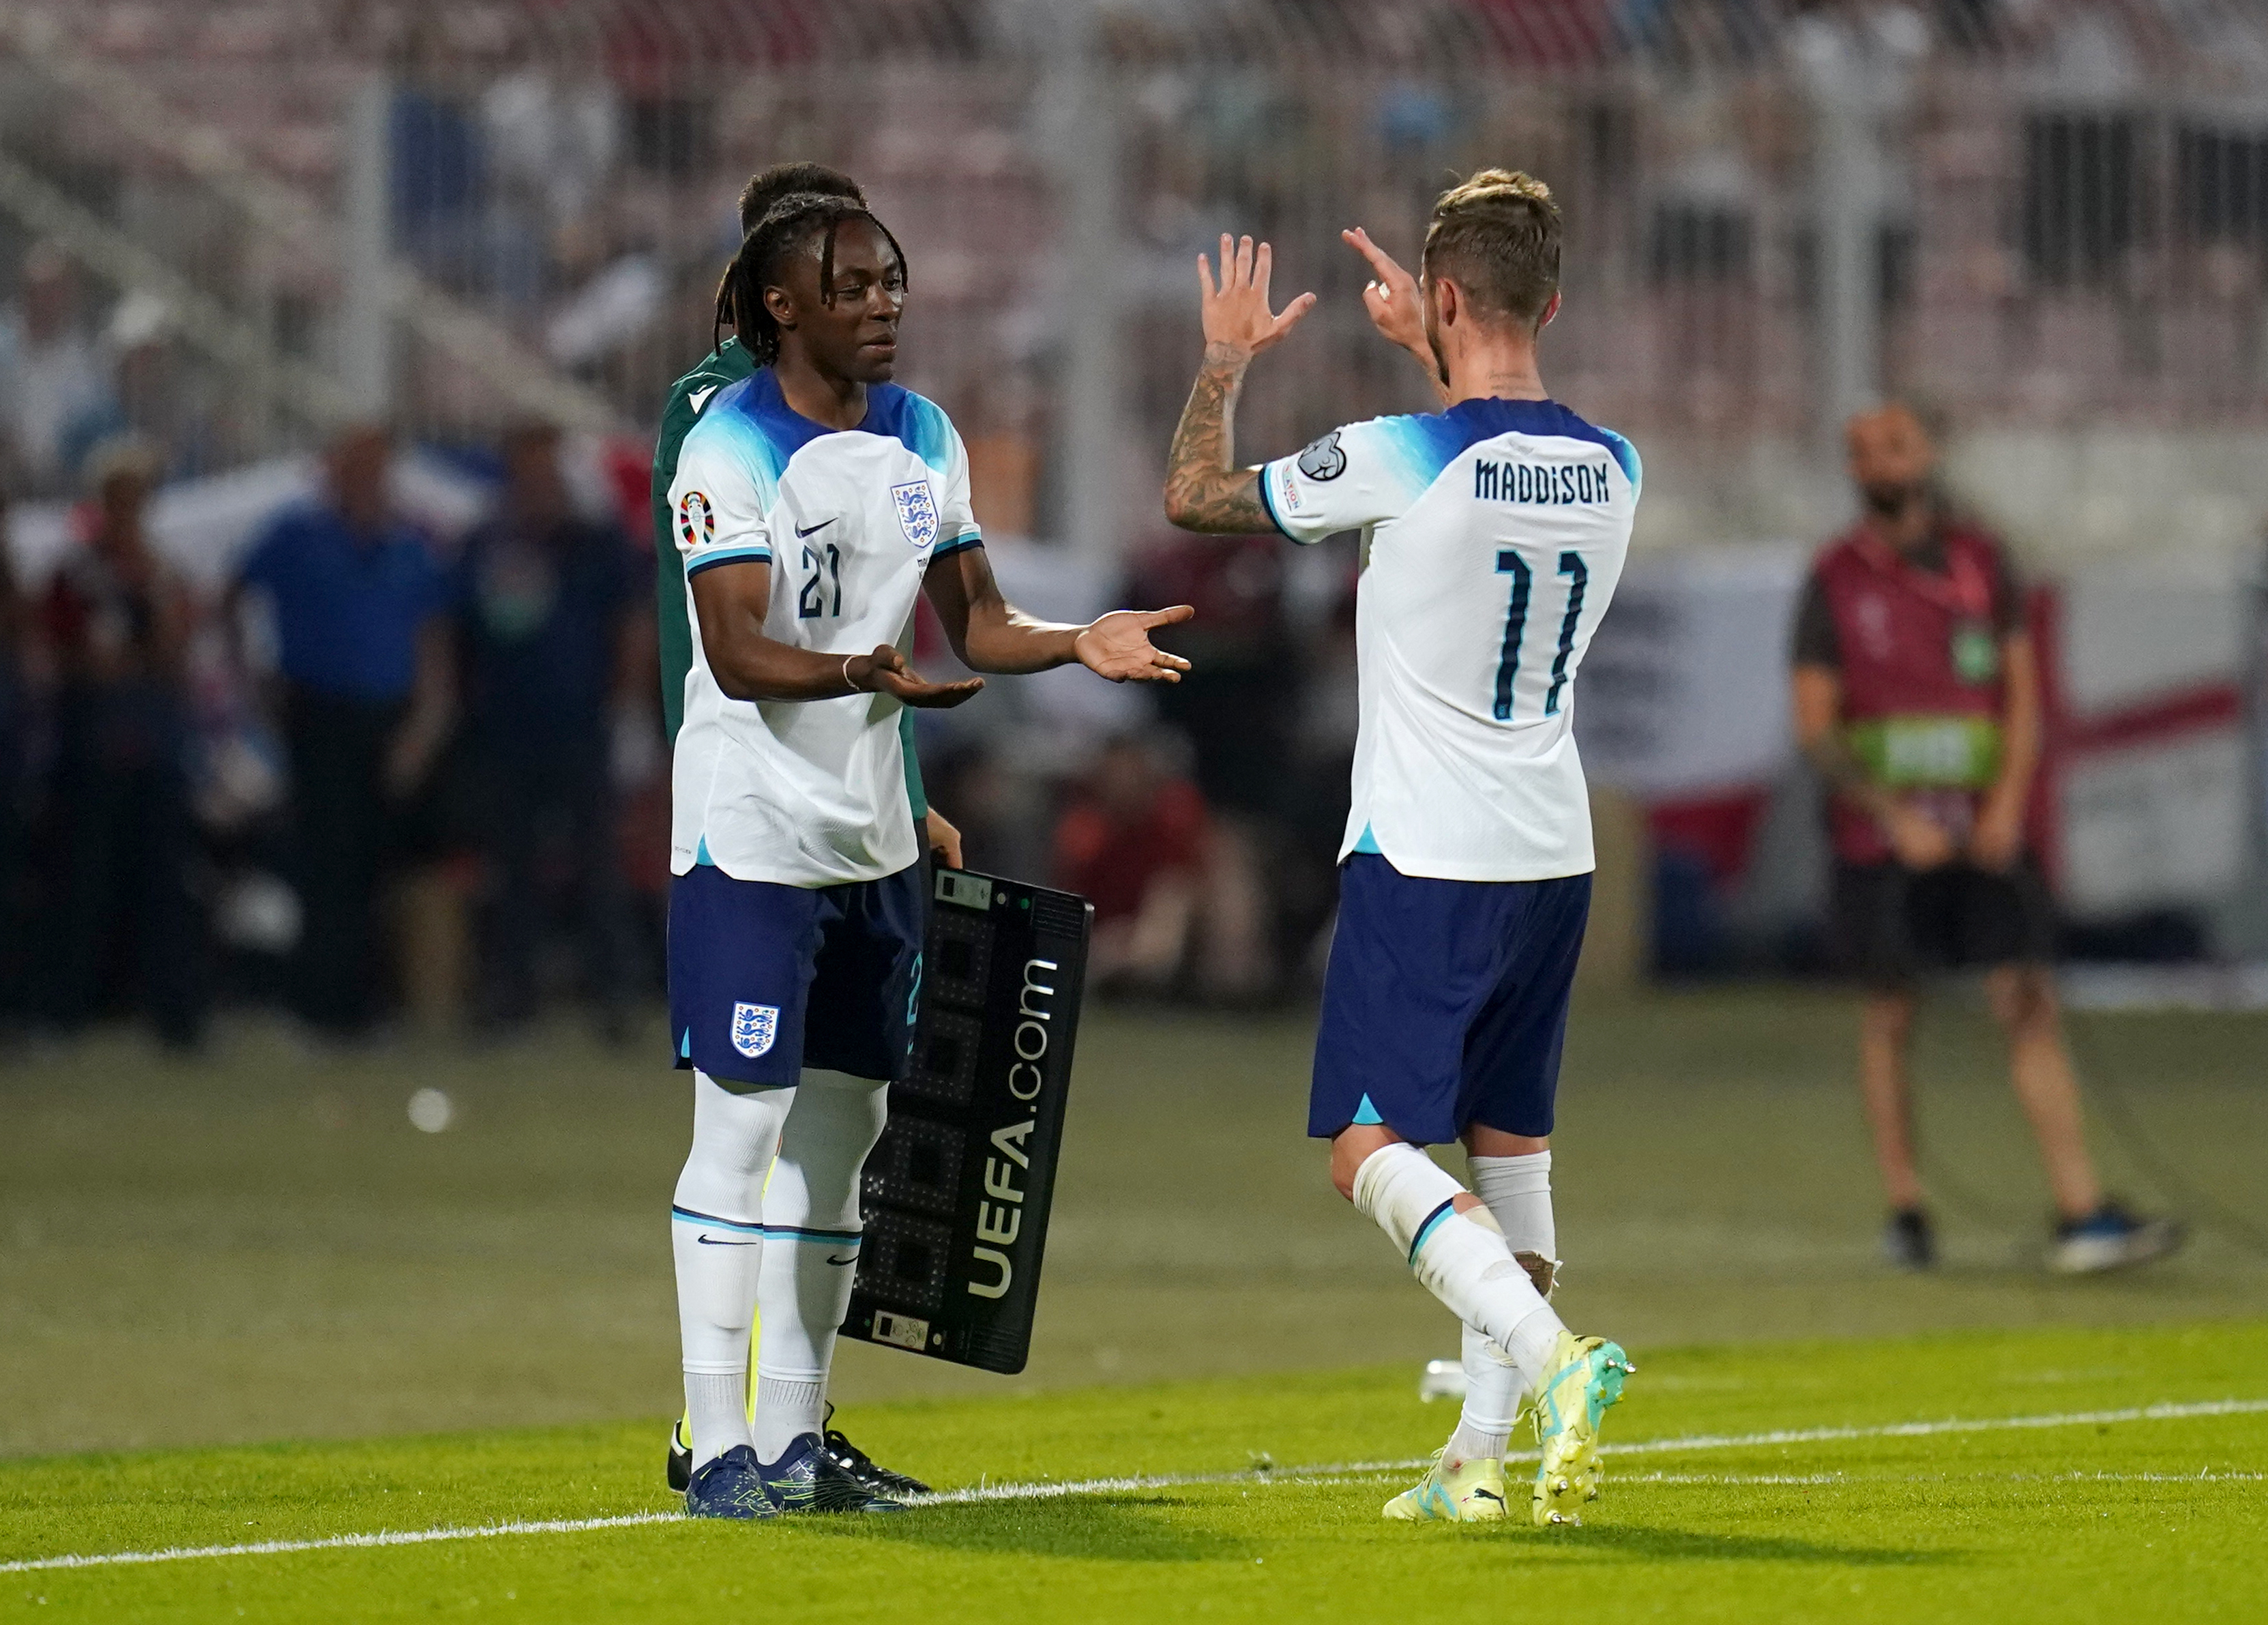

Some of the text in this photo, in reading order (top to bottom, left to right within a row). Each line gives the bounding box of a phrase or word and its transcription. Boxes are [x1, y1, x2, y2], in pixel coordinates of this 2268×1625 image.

[799, 543, 841, 619] 21
[1494, 548, 1589, 721] 11
[967, 958, 1057, 1299] UEFA.com
